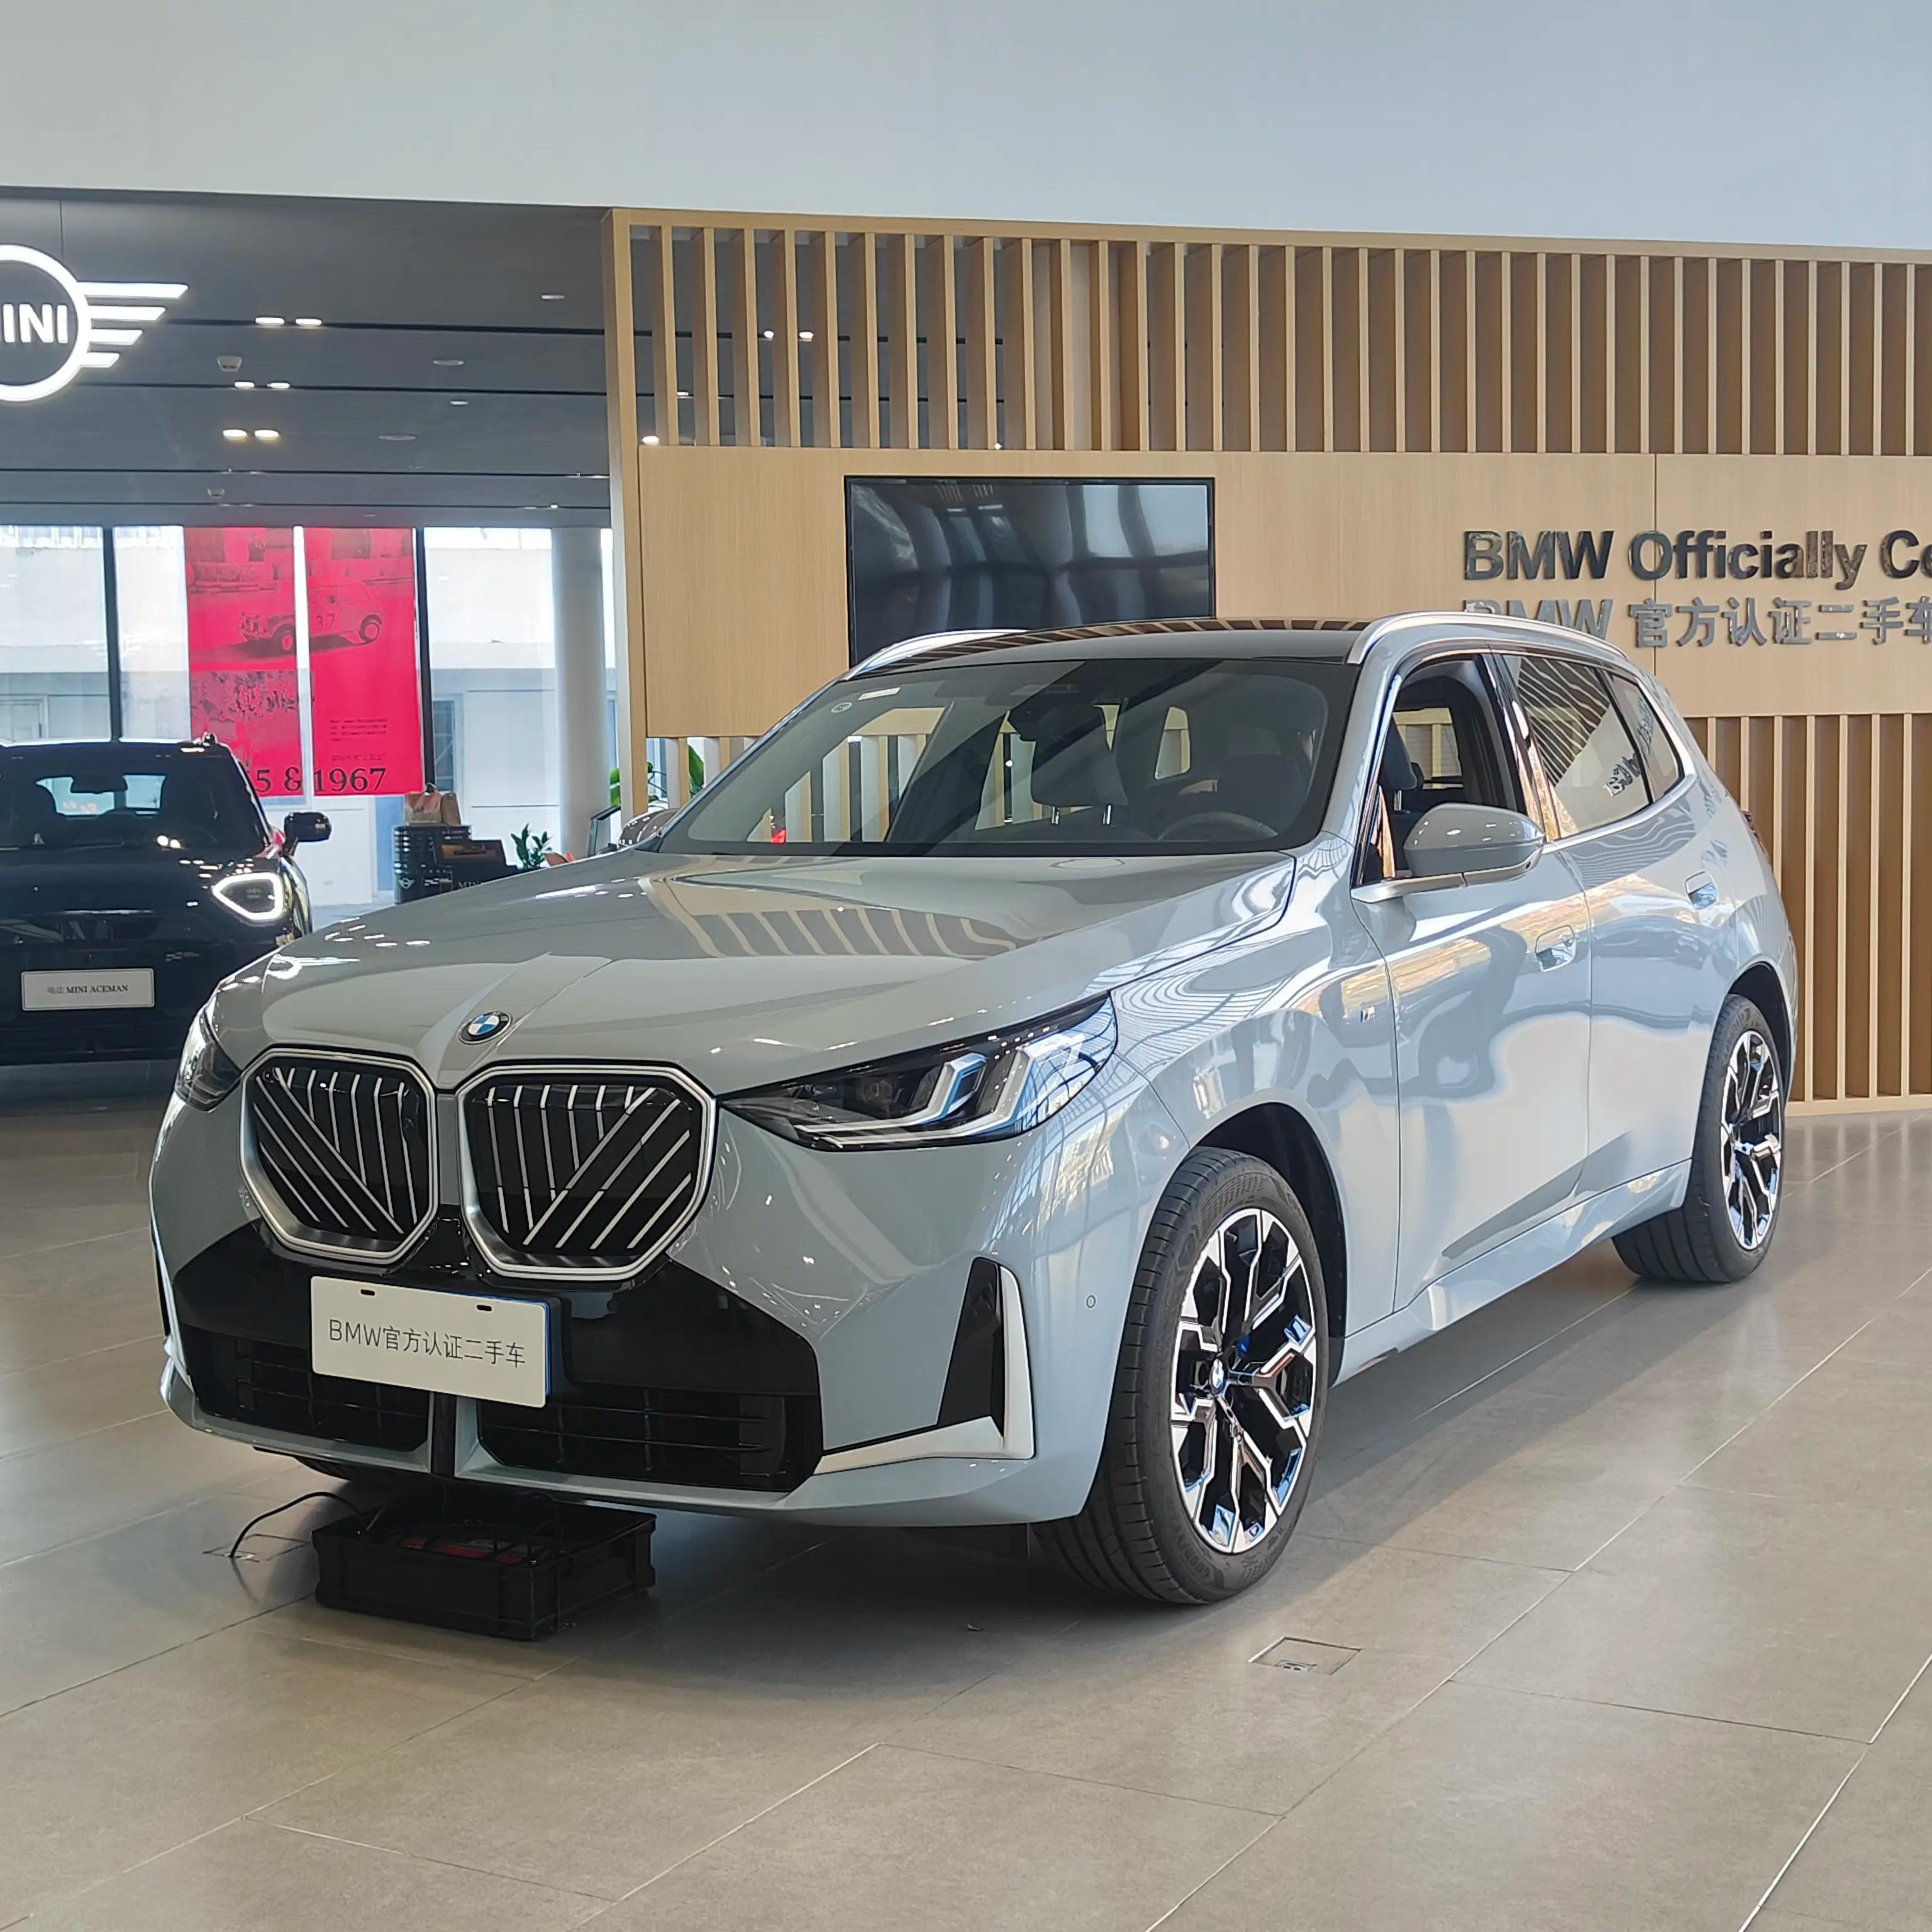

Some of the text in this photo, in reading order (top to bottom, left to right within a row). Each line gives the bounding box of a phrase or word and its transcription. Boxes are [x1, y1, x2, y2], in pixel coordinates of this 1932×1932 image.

[0, 303, 69, 343] INI
[1463, 530, 1614, 580] BMW
[1628, 530, 1867, 590] Officially
[1629, 597, 1932, 648] 官方认证二手车
[248, 766, 386, 792] 5 & 1967
[65, 985, 87, 994] MINI
[91, 984, 128, 993] ACEMAN
[329, 1319, 526, 1368] BMW官方认证二手车
